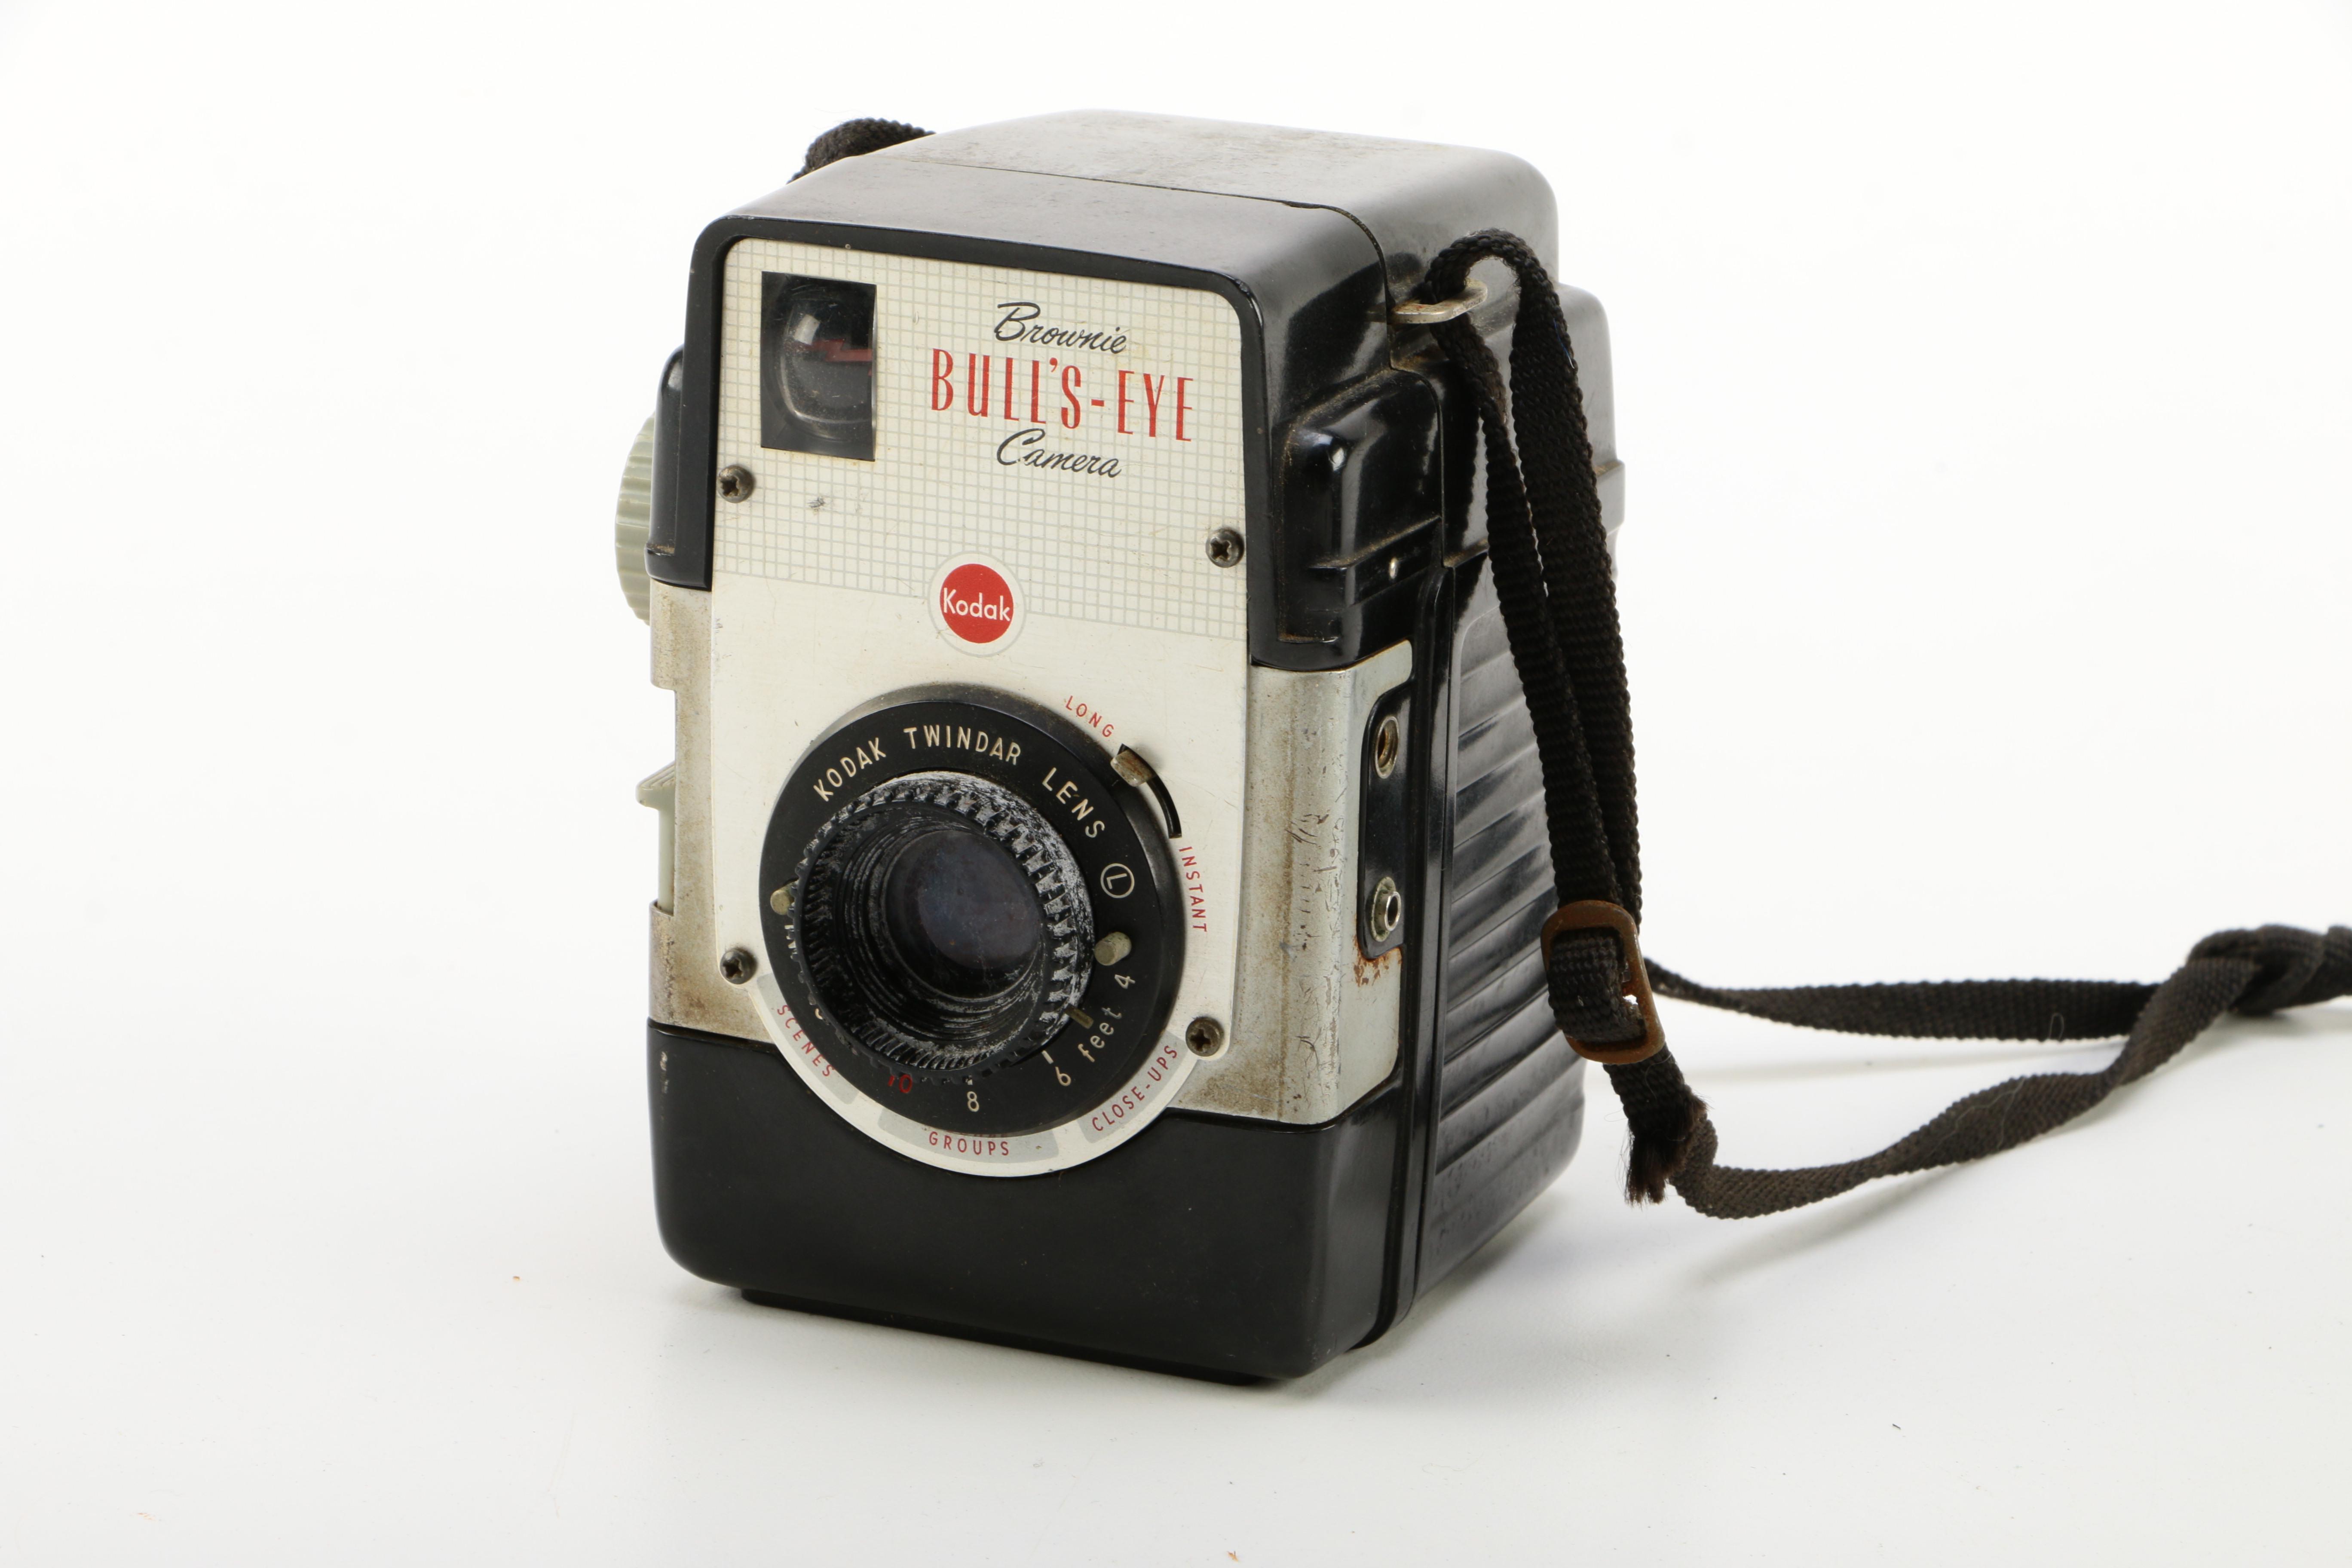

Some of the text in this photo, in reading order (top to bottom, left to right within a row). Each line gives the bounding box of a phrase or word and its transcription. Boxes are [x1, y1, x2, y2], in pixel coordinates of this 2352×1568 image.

[994, 302, 1127, 354] Brownie
[931, 348, 1194, 442] BULL'S-EYE
[996, 428, 1122, 478] Camera
[943, 588, 1010, 622] Kodak
[1064, 695, 1115, 738] LONG
[813, 738, 886, 802] KODAK
[903, 725, 1020, 765] TWINDAR
[1042, 767, 1105, 838] LENS
[1179, 846, 1207, 932] INSTANT
[777, 1004, 836, 1077] SCENES
[967, 1091, 980, 1112] 8
[1055, 1066, 1071, 1086] 6
[1078, 1007, 1122, 1062] feet
[1115, 974, 1136, 989] 4
[1092, 1045, 1178, 1131] CLOSE-UPS
[929, 1131, 1009, 1156] GROUPS
